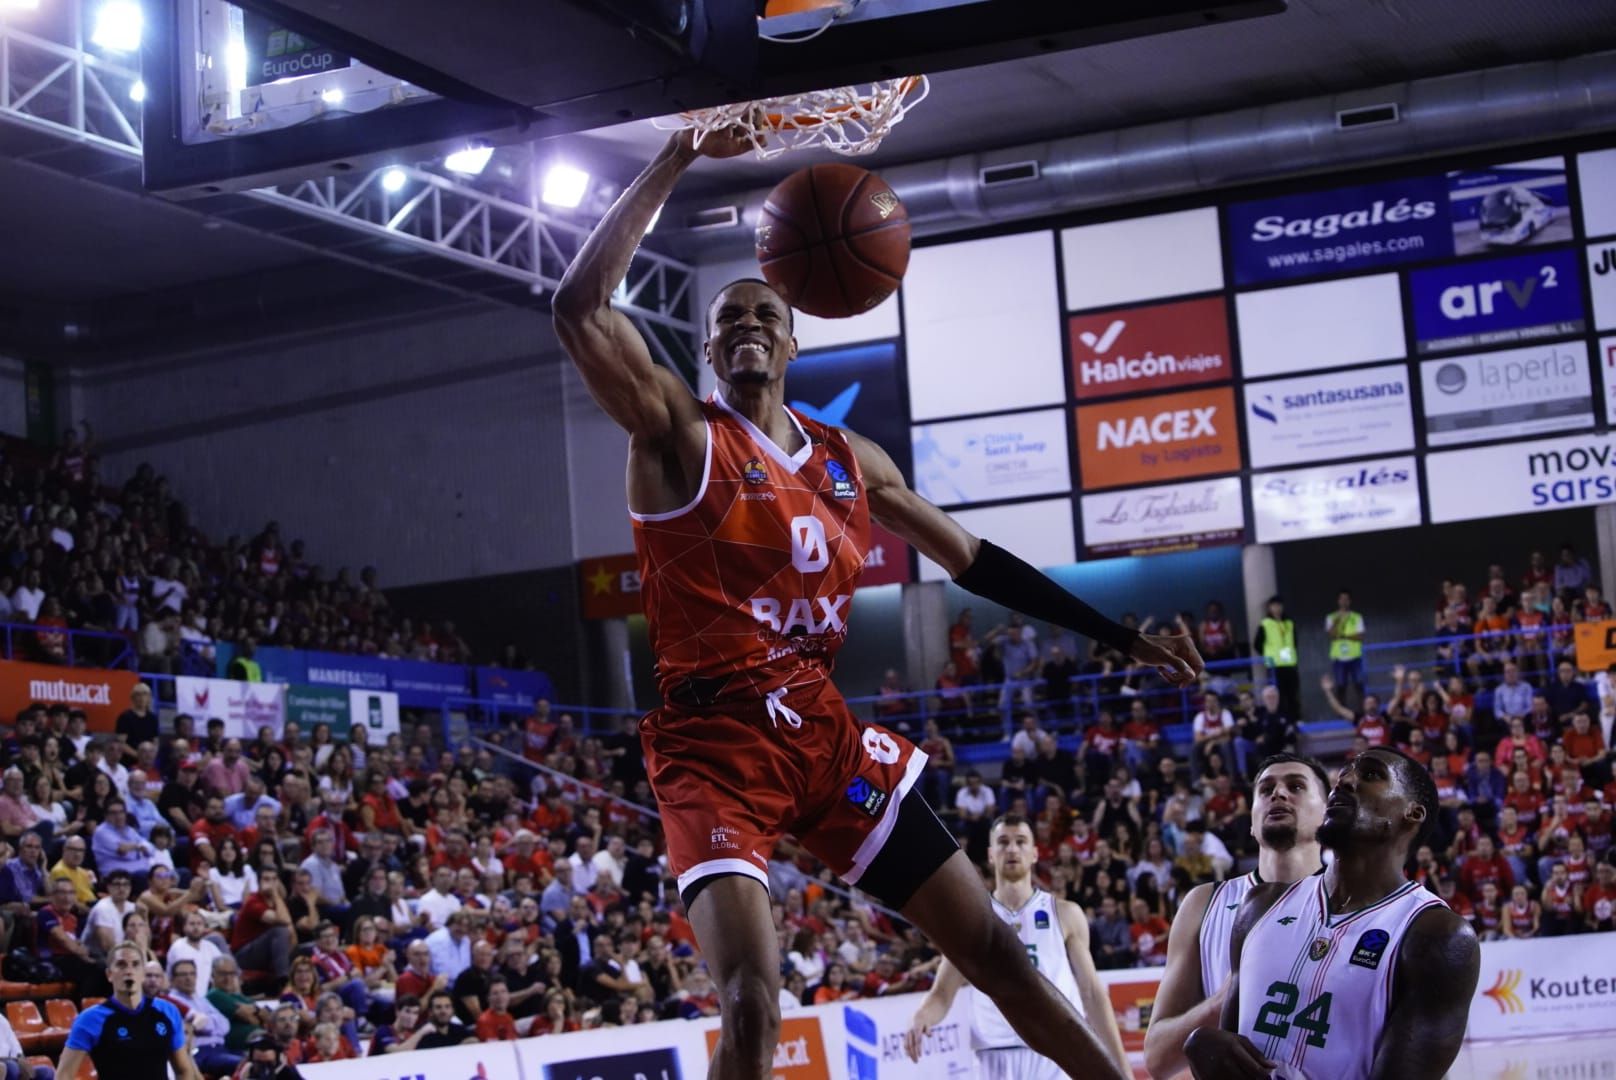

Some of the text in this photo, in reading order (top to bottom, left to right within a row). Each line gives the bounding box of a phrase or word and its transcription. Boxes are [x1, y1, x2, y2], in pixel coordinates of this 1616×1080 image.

[263, 53, 333, 77] EuroCup
[1251, 198, 1436, 241] Sagalés
[1267, 235, 1425, 268] www.sagales.com
[1080, 351, 1223, 385] Halcón viajes
[1283, 382, 1405, 410] santasusana
[1096, 406, 1217, 451] NACEX
[1141, 452, 1158, 465] by
[1528, 444, 1616, 476] mov
[1532, 476, 1616, 506] sars
[791, 515, 829, 573] 0
[30, 679, 111, 705] mutuacat
[711, 841, 742, 850] GLOBAL
[712, 834, 728, 843] ETL
[1352, 955, 1378, 967] EuroCup
[1358, 949, 1377, 958] BKT
[1253, 981, 1333, 1049] 24
